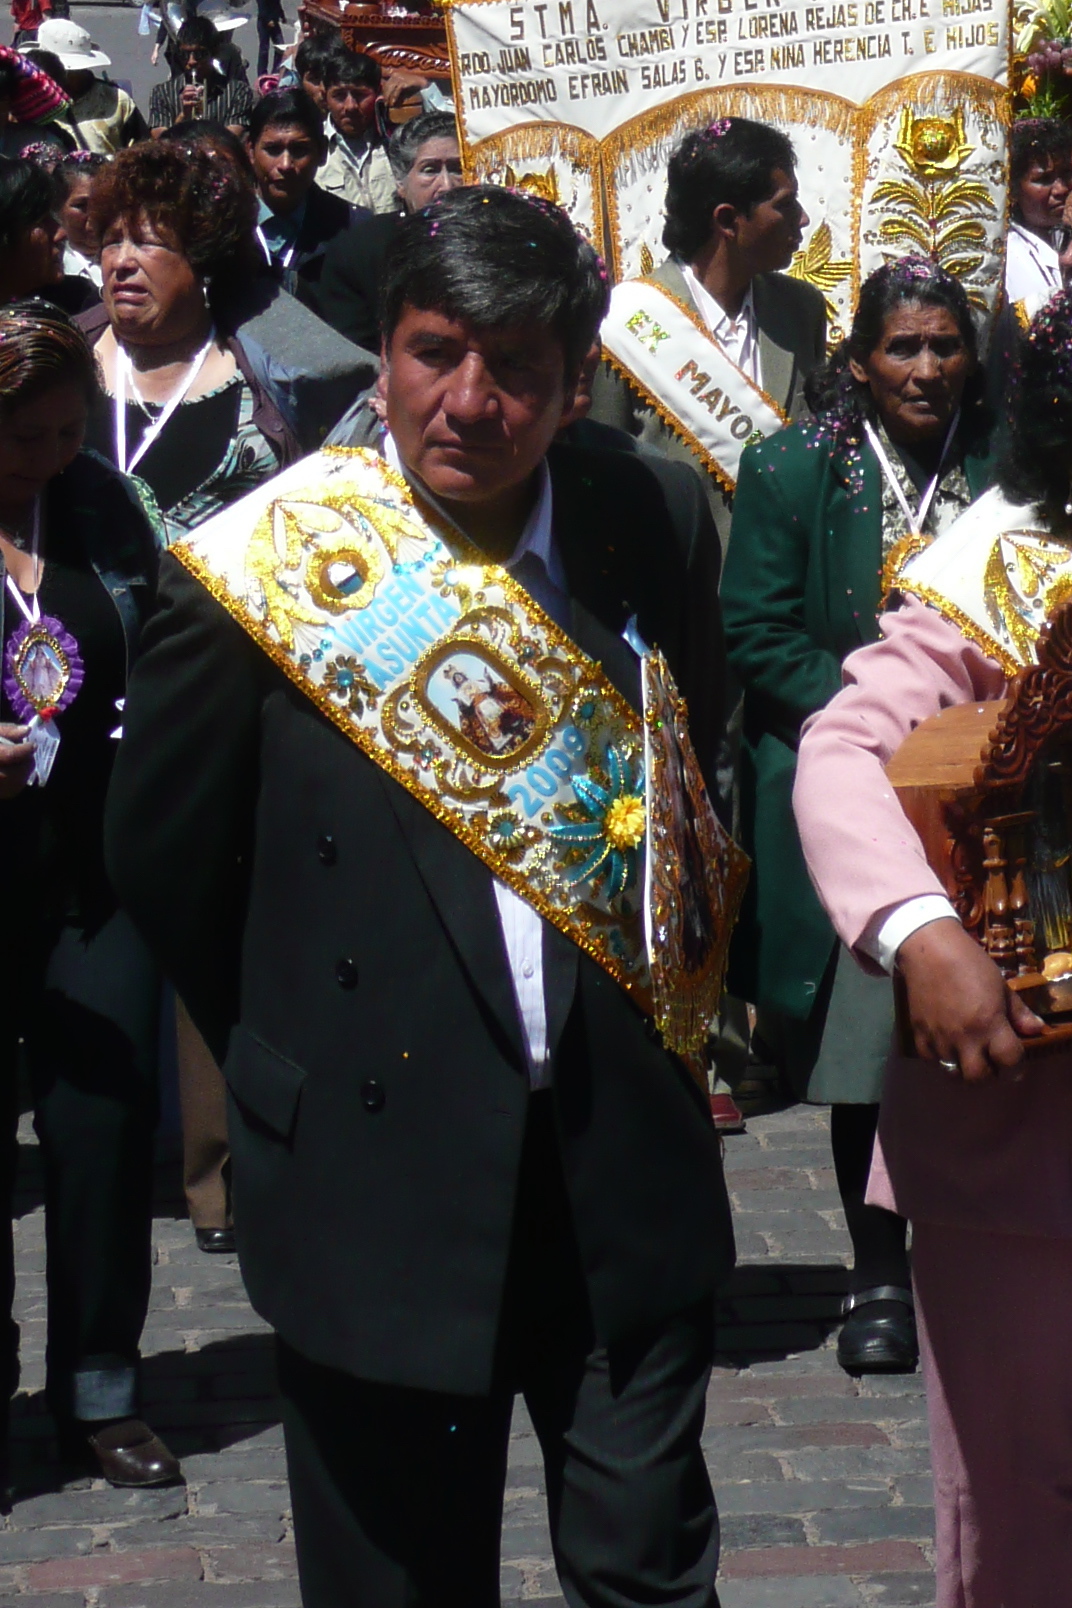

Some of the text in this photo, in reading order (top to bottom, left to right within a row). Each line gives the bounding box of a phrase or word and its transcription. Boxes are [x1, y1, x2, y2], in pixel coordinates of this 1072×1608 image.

[469, 78, 558, 110] MAYORDOMO
[569, 70, 629, 100] EFRAIN
[641, 61, 686, 90] SALAS
[718, 52, 727, 79] Y
[734, 48, 765, 76] ESP.
[770, 44, 805, 71] NINA
[813, 33, 892, 66] HERENCIA
[901, 31, 914, 55] T.
[923, 28, 937, 54] E
[946, 21, 999, 51] HIJOS
[543, 35, 607, 68] CARLOS
[617, 26, 675, 58] CHAMBI
[681, 23, 690, 48] Y
[696, 19, 728, 45] ESP.
[738, 9, 798, 40] LORENA
[805, 2, 858, 31] REJAS
[864, 0, 885, 25] DE
[624, 308, 671, 357] EX
[333, 574, 425, 655] VIRGEN
[362, 593, 462, 692] ASUNTA
[508, 725, 586, 819] 2009
